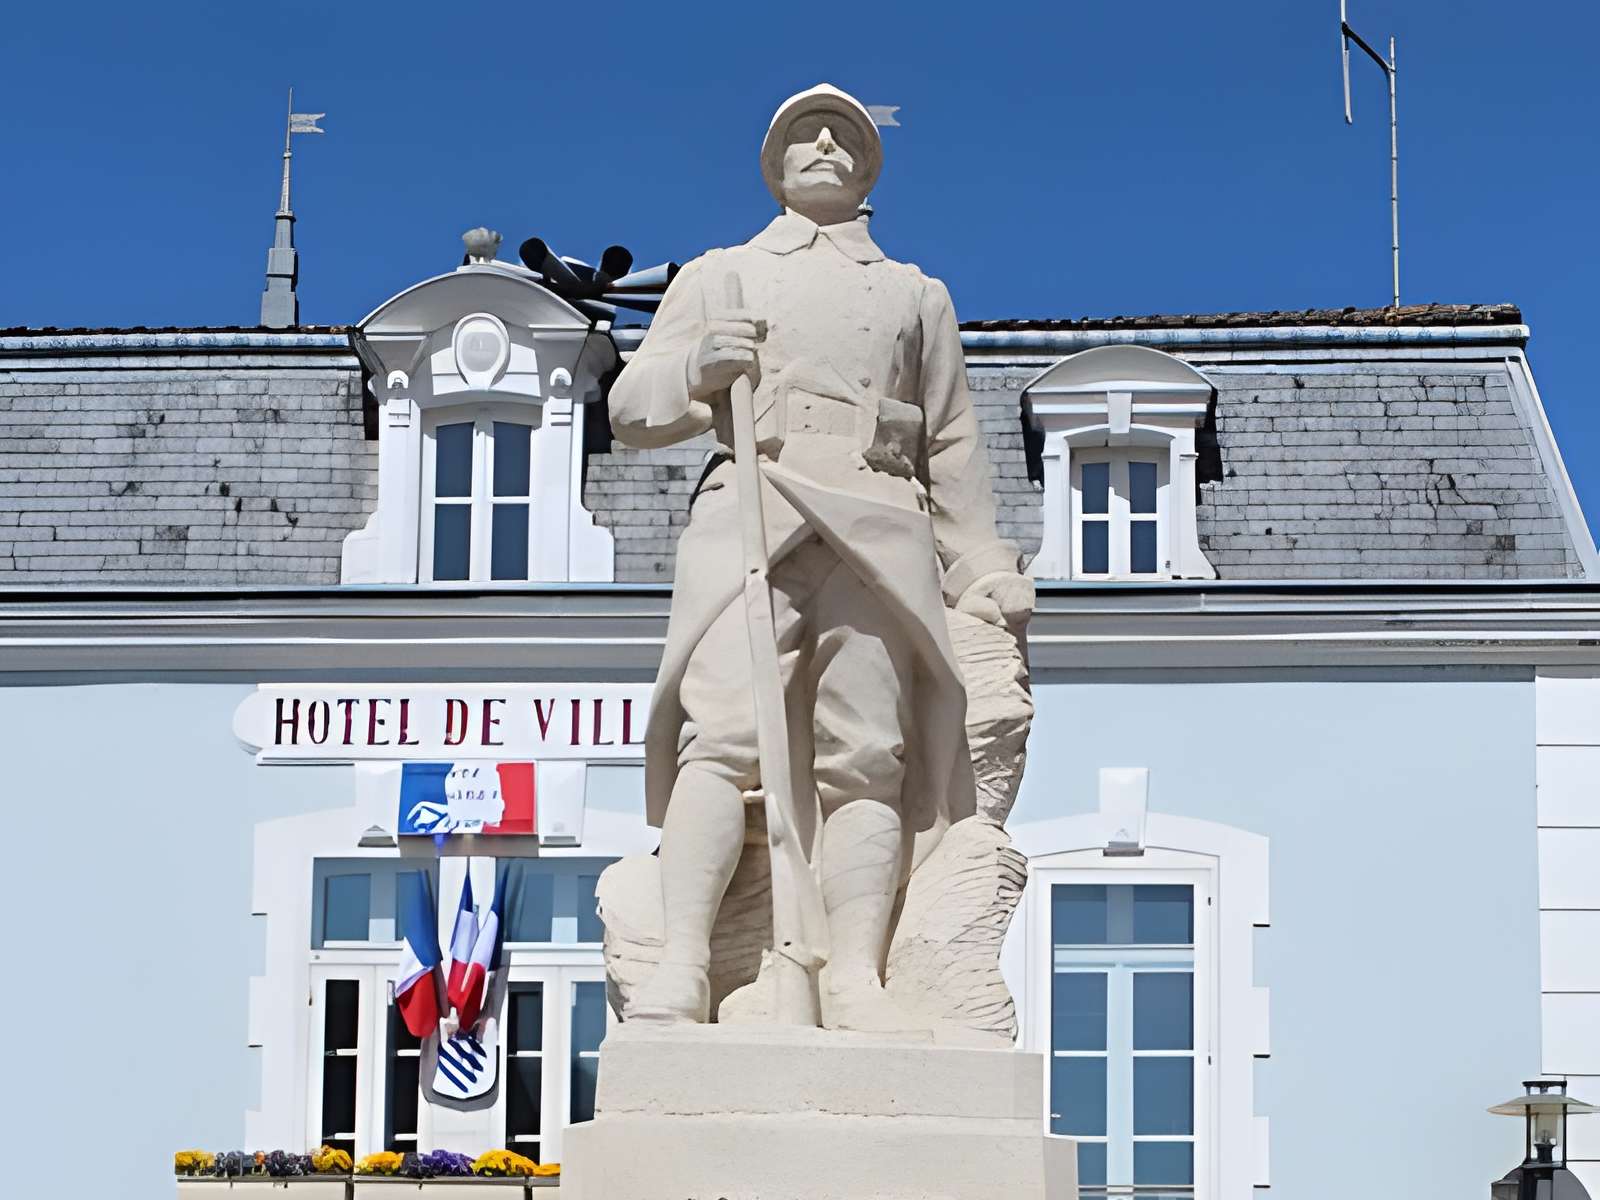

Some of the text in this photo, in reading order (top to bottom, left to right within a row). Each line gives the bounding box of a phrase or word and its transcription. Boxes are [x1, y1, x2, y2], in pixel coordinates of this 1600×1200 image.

[274, 698, 646, 746] HOTEL DE VILL
